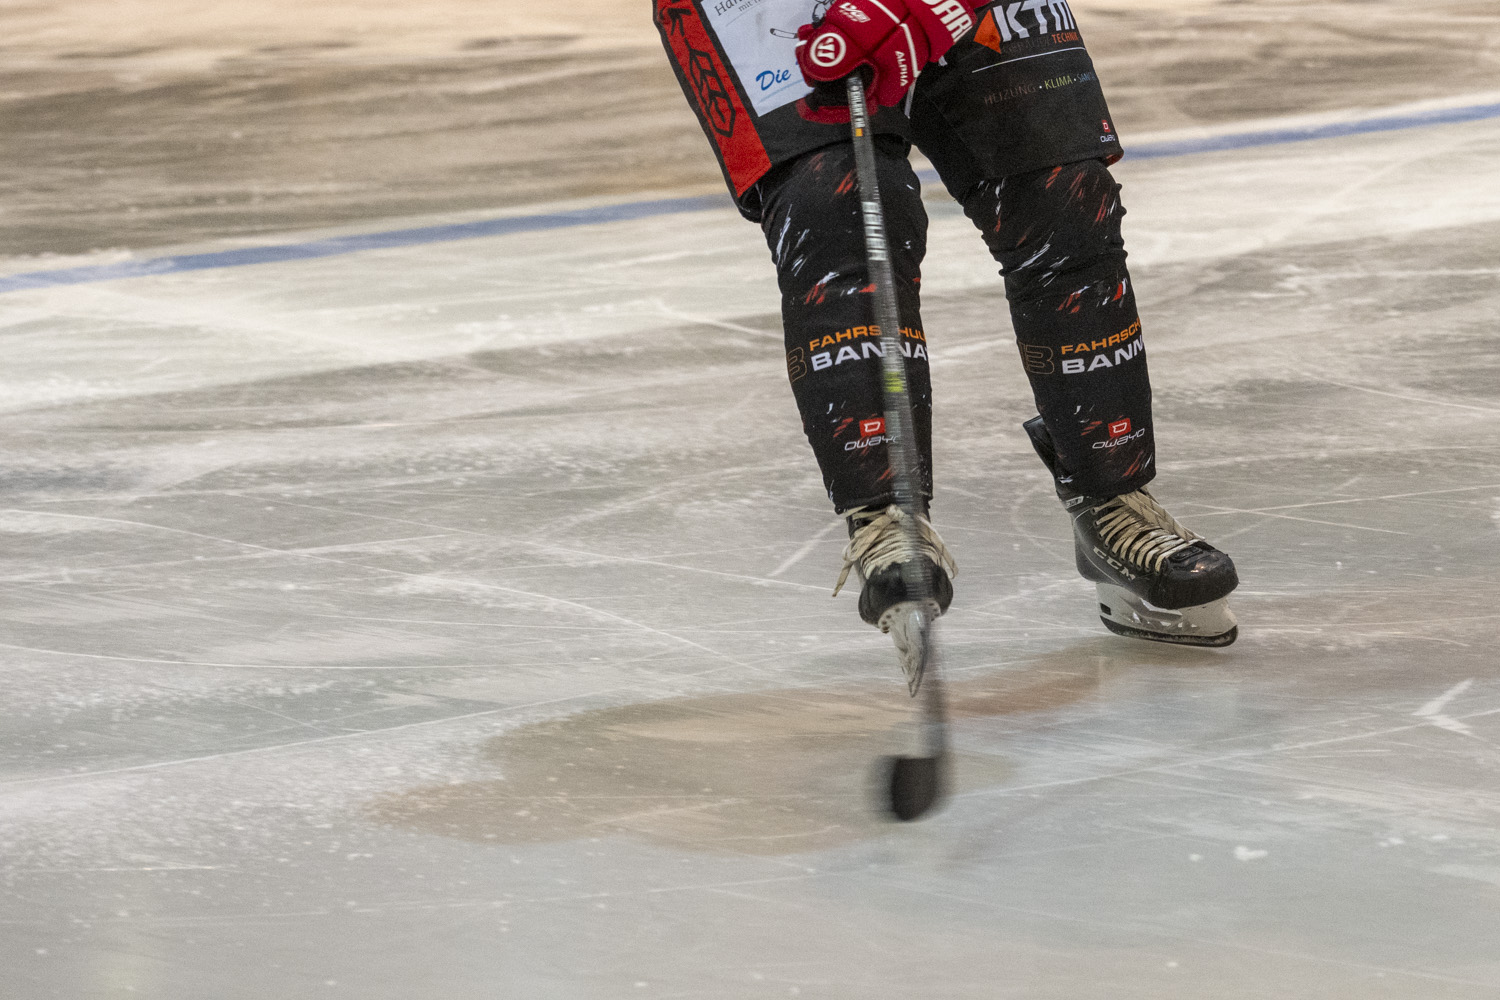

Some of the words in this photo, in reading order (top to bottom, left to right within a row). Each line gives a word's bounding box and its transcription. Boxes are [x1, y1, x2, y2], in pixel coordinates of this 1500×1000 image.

[738, 1, 754, 12] mit
[756, 69, 792, 91] Die
[895, 50, 909, 87] ALPHA
[1044, 75, 1073, 90] KLIMA
[811, 341, 929, 372] BANNA
[1093, 545, 1136, 581] CCM
